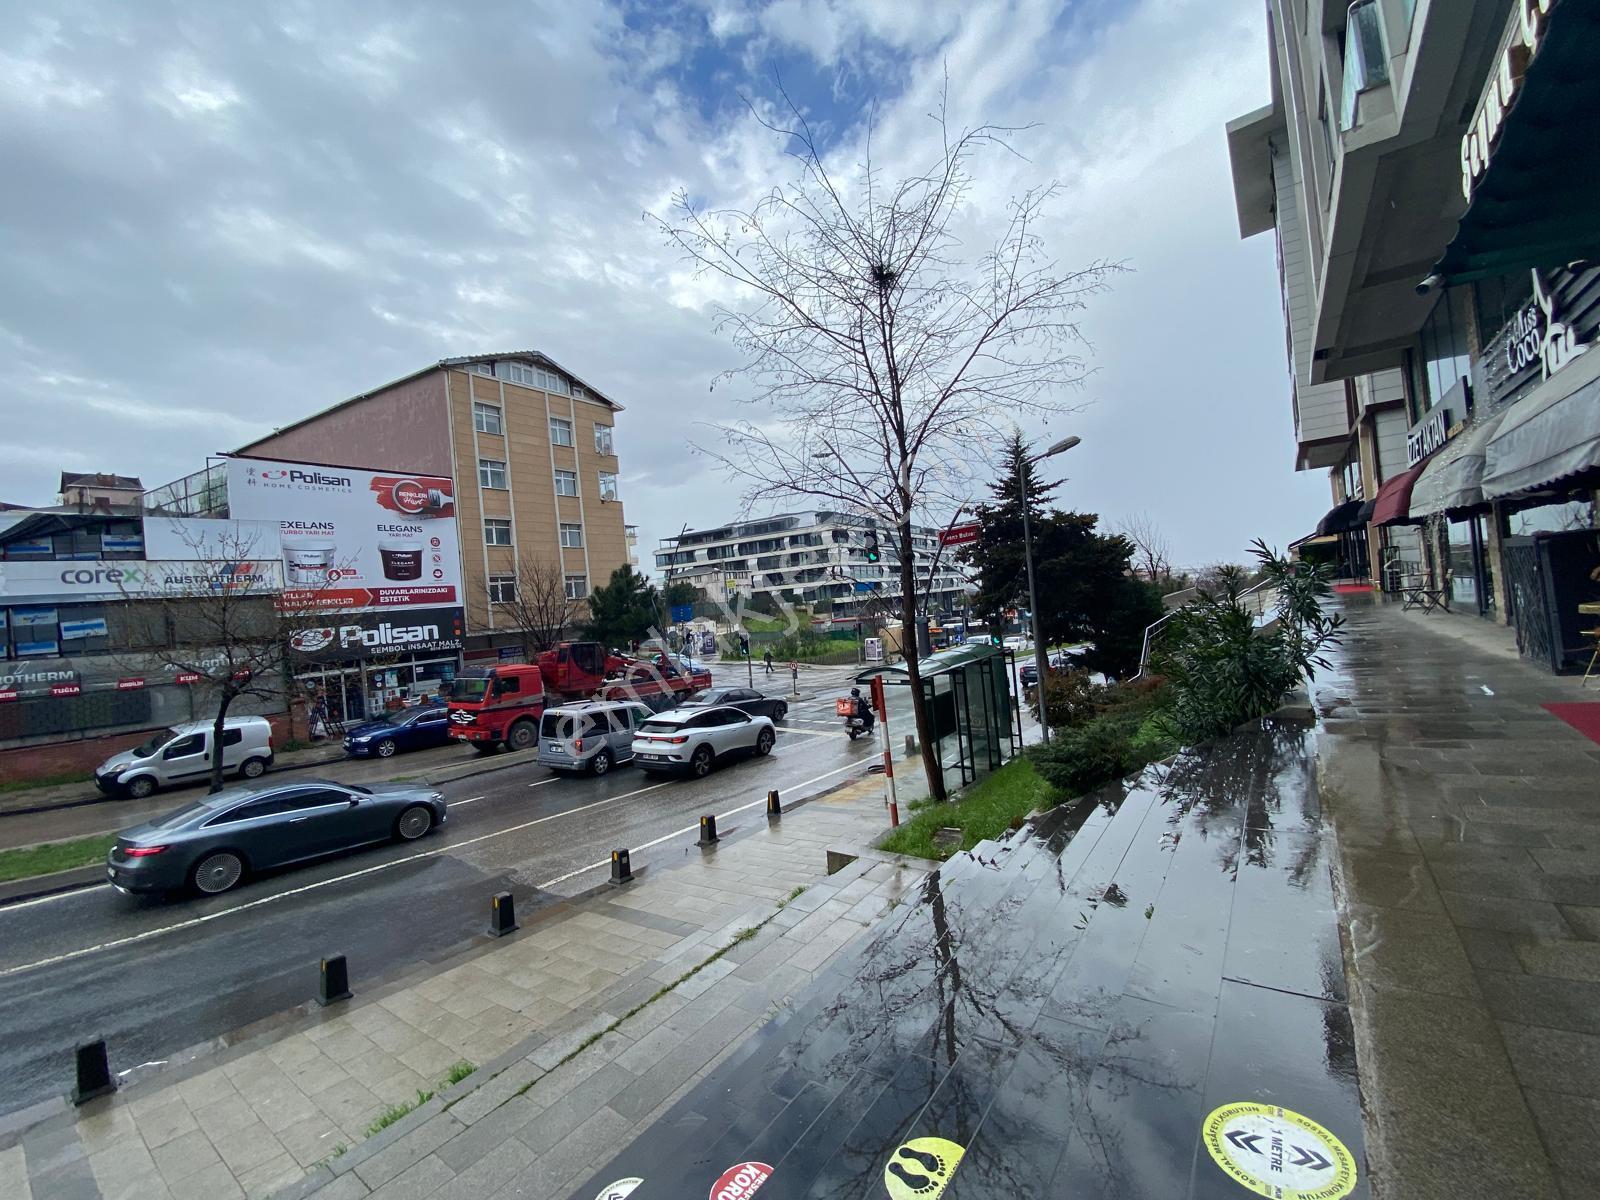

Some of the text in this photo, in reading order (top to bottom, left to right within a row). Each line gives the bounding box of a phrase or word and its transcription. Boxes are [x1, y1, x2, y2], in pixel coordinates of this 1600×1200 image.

[290, 470, 351, 487] Polisan
[298, 485, 353, 494] COSMETICS
[377, 524, 423, 533] ELEGANS
[61, 568, 141, 585] corex
[164, 574, 264, 585] AUSTROTHERM
[339, 623, 440, 649] Polisan
[370, 646, 406, 654] SEMBOL
[1217, 1106, 1260, 1123] KORUYUN
[1296, 1118, 1333, 1144] SOSYAL
[1270, 1137, 1283, 1173] METRE
[1220, 1155, 1257, 1186] SOSYAL
